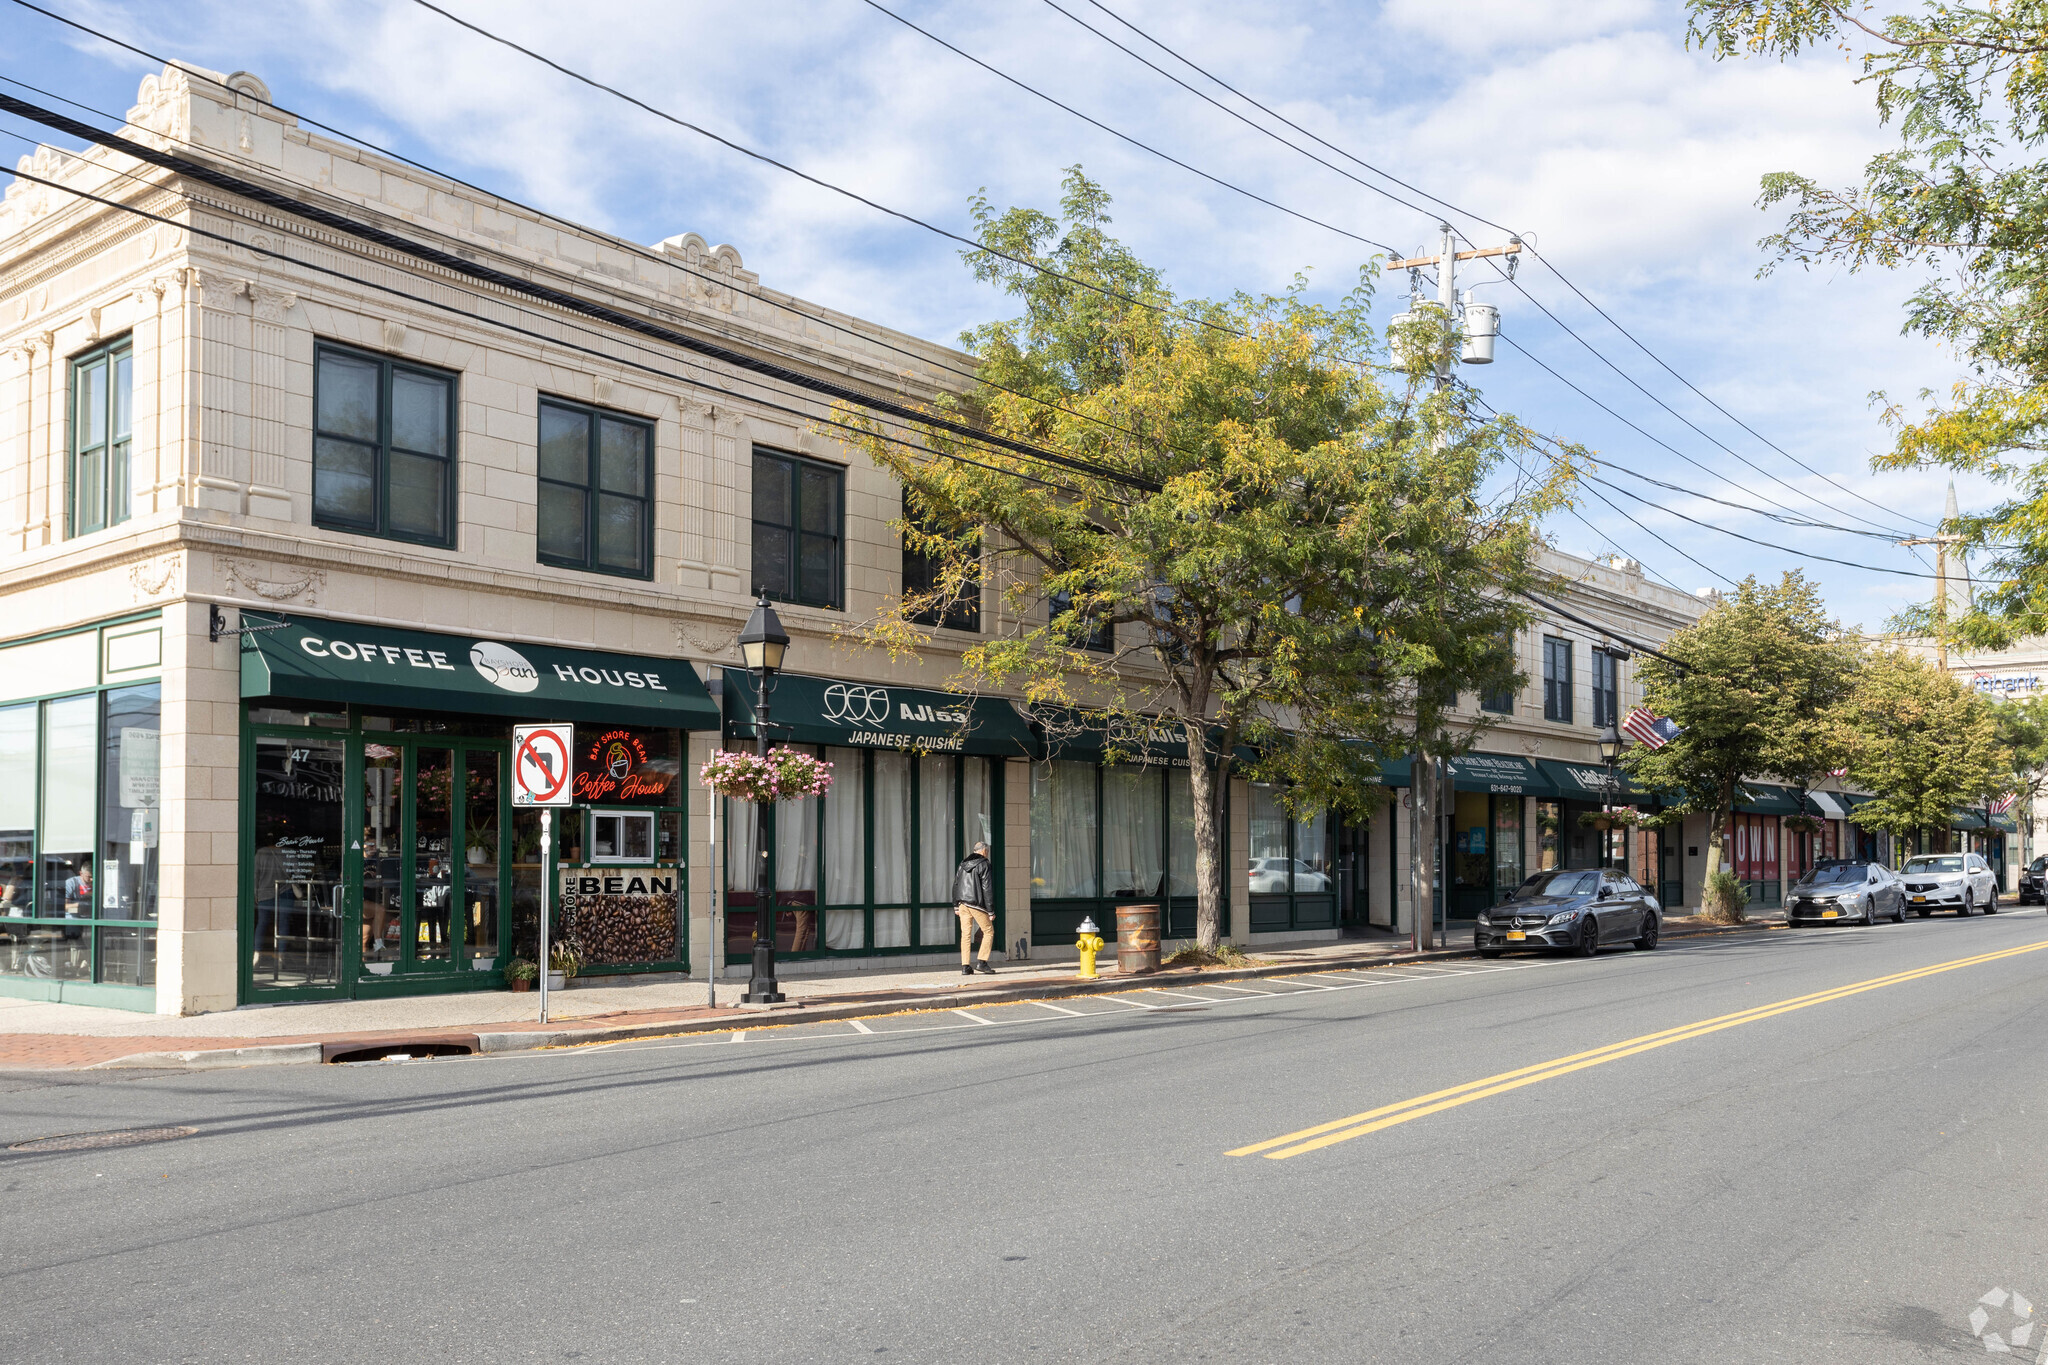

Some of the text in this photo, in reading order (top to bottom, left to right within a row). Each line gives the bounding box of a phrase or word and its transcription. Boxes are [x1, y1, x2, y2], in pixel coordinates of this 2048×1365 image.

[300, 637, 668, 691] COFFEE HOUSE
[590, 730, 648, 764] BAY SHORE BEAN
[848, 731, 964, 750] JAPANESE CUISINE
[291, 749, 310, 762] 47
[1172, 758, 1191, 767] CUIS
[572, 772, 664, 799] Coffee House
[1490, 784, 1522, 793] 631-647-9020
[275, 836, 298, 847] Bean
[579, 876, 672, 894] BEAN
